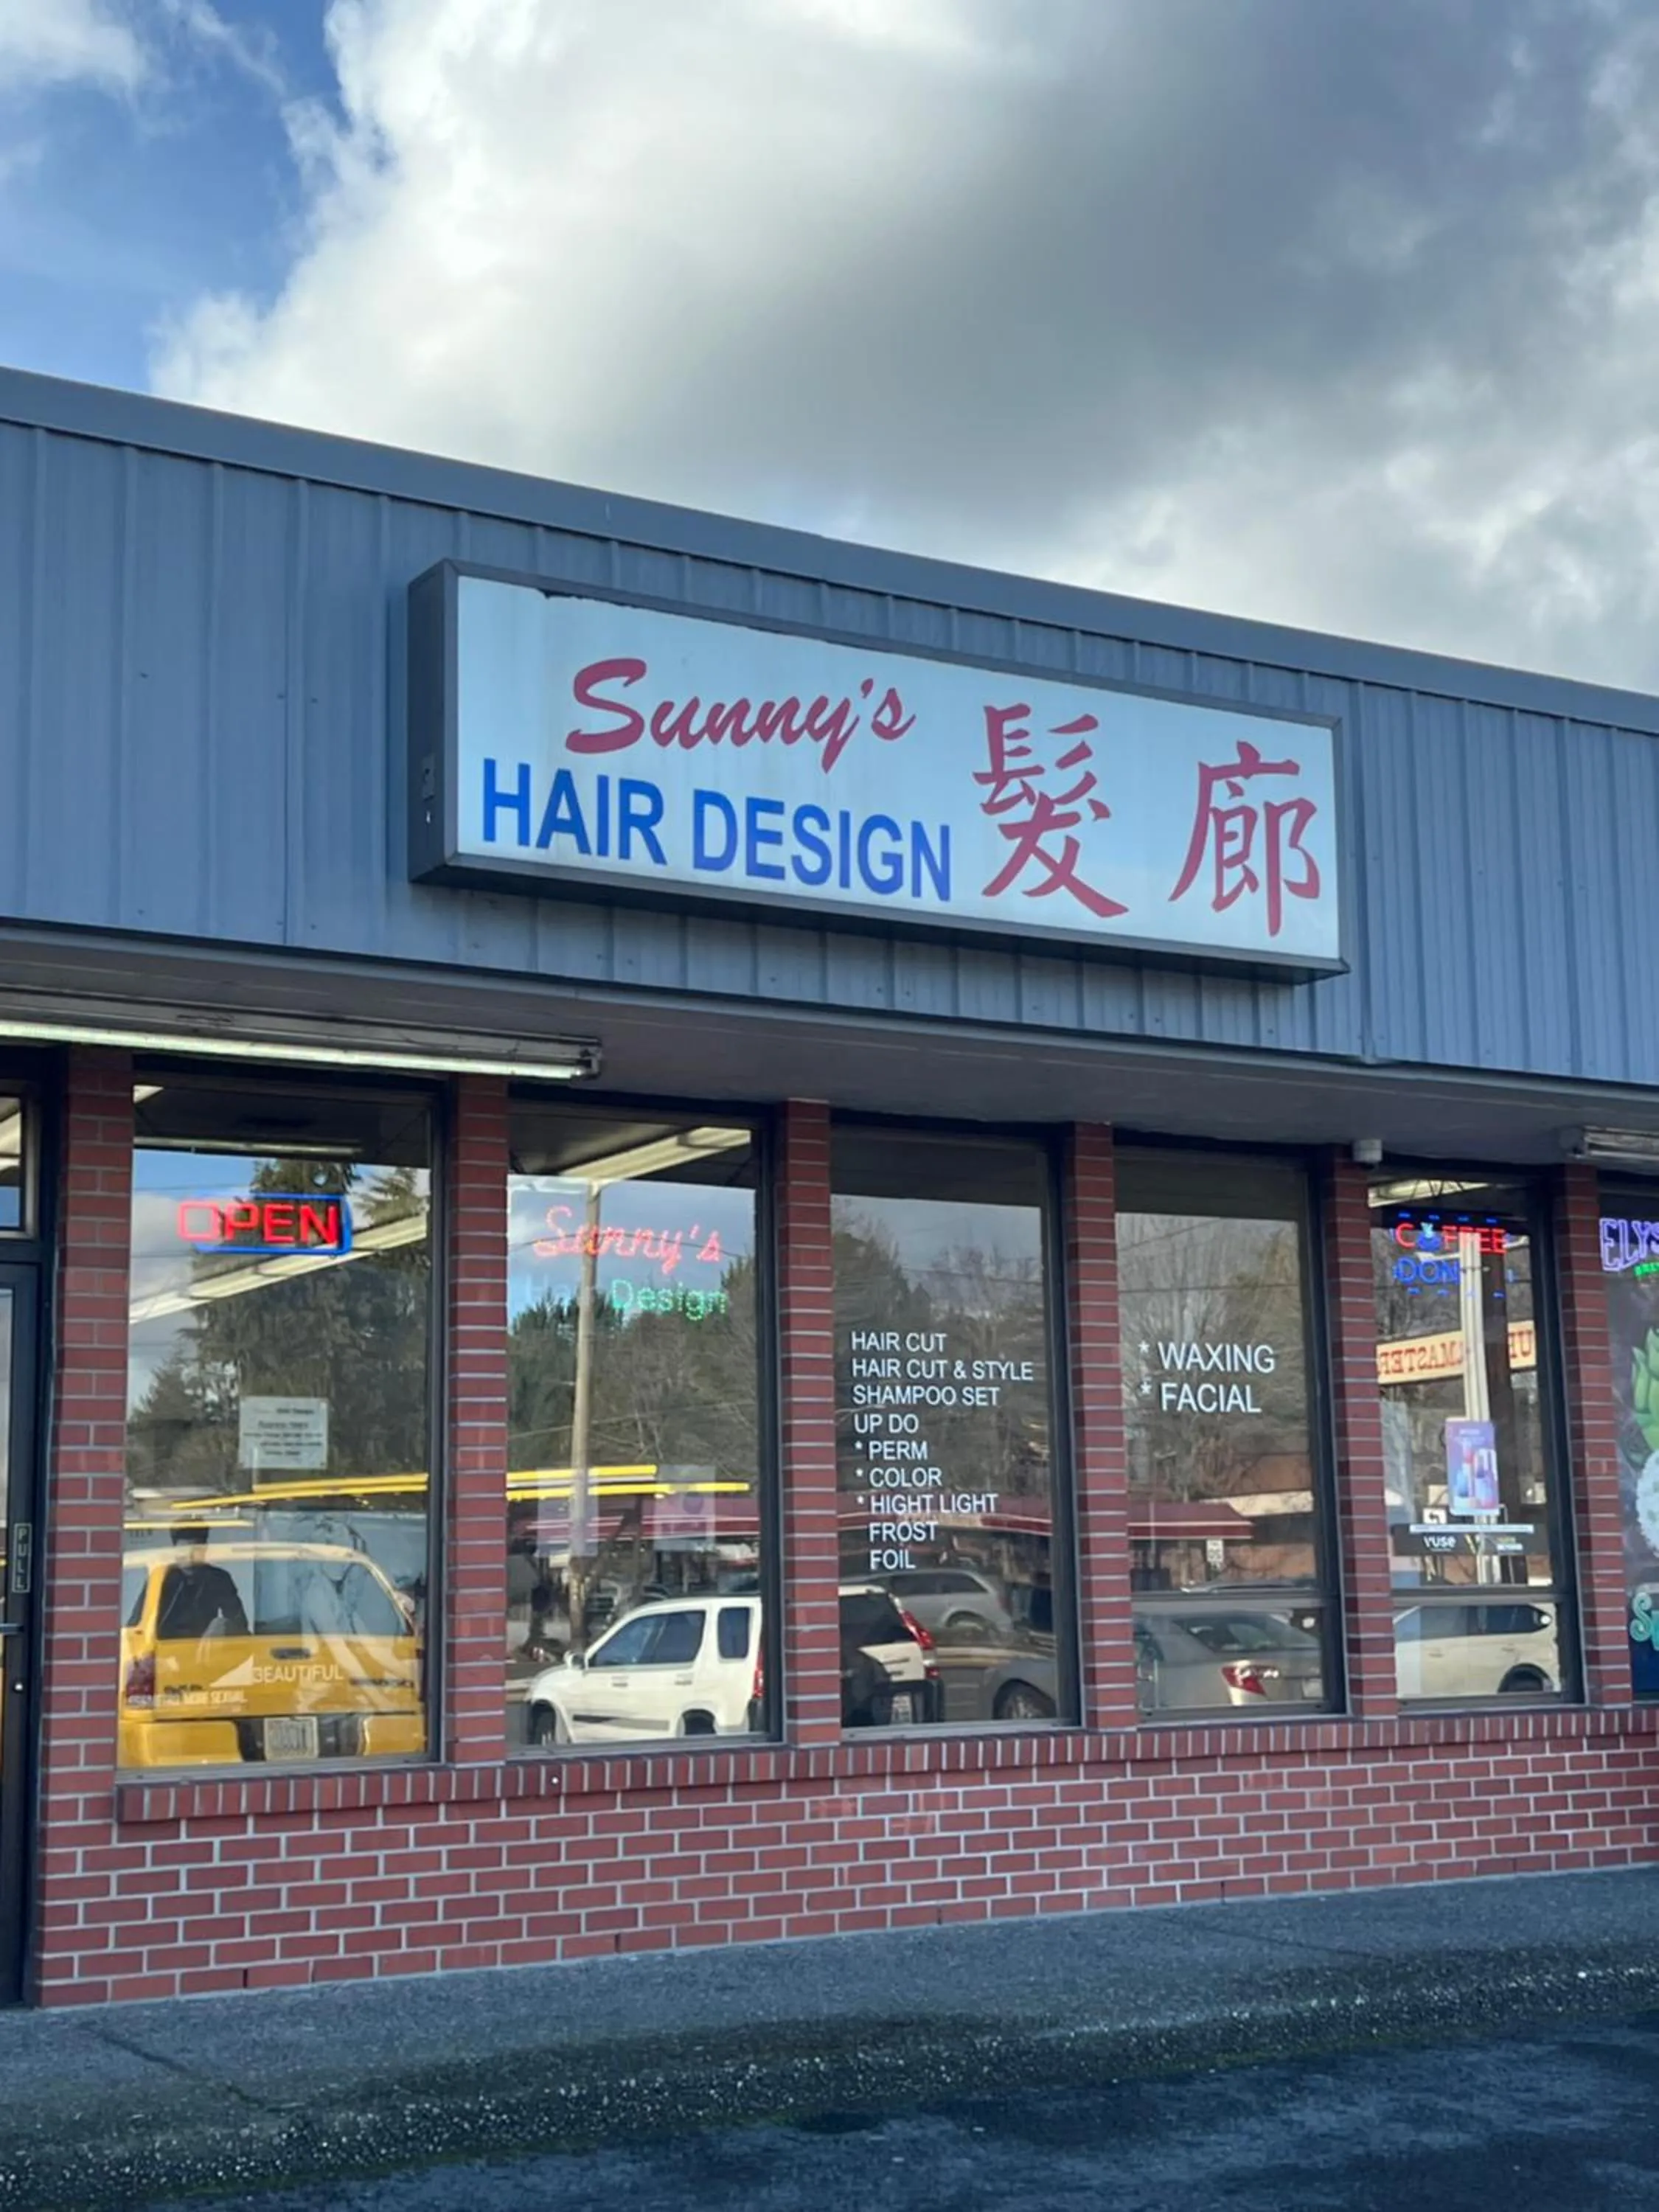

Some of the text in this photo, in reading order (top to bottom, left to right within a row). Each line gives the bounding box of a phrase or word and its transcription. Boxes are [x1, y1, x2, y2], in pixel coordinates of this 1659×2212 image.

[566, 658, 916, 773] Sunny's
[481, 757, 951, 902] HAIR DESIGN
[177, 1200, 340, 1245] OPEN
[533, 1205, 723, 1275] Sunny's
[611, 1279, 728, 1321] Design
[852, 1330, 947, 1353] HAIR CUT
[852, 1357, 1034, 1381] HAIR CUT & STYLE
[1158, 1341, 1276, 1374] WAXING
[852, 1384, 1001, 1406] SHAMPOO SET
[1161, 1382, 1262, 1413] FACIAL
[854, 1413, 919, 1434] UP DO
[869, 1440, 928, 1461] PERM
[869, 1467, 943, 1488] COLOR
[870, 1493, 999, 1515] HIGHT LIGHT
[869, 1521, 939, 1543] FROST
[870, 1548, 917, 1571] FOIL
